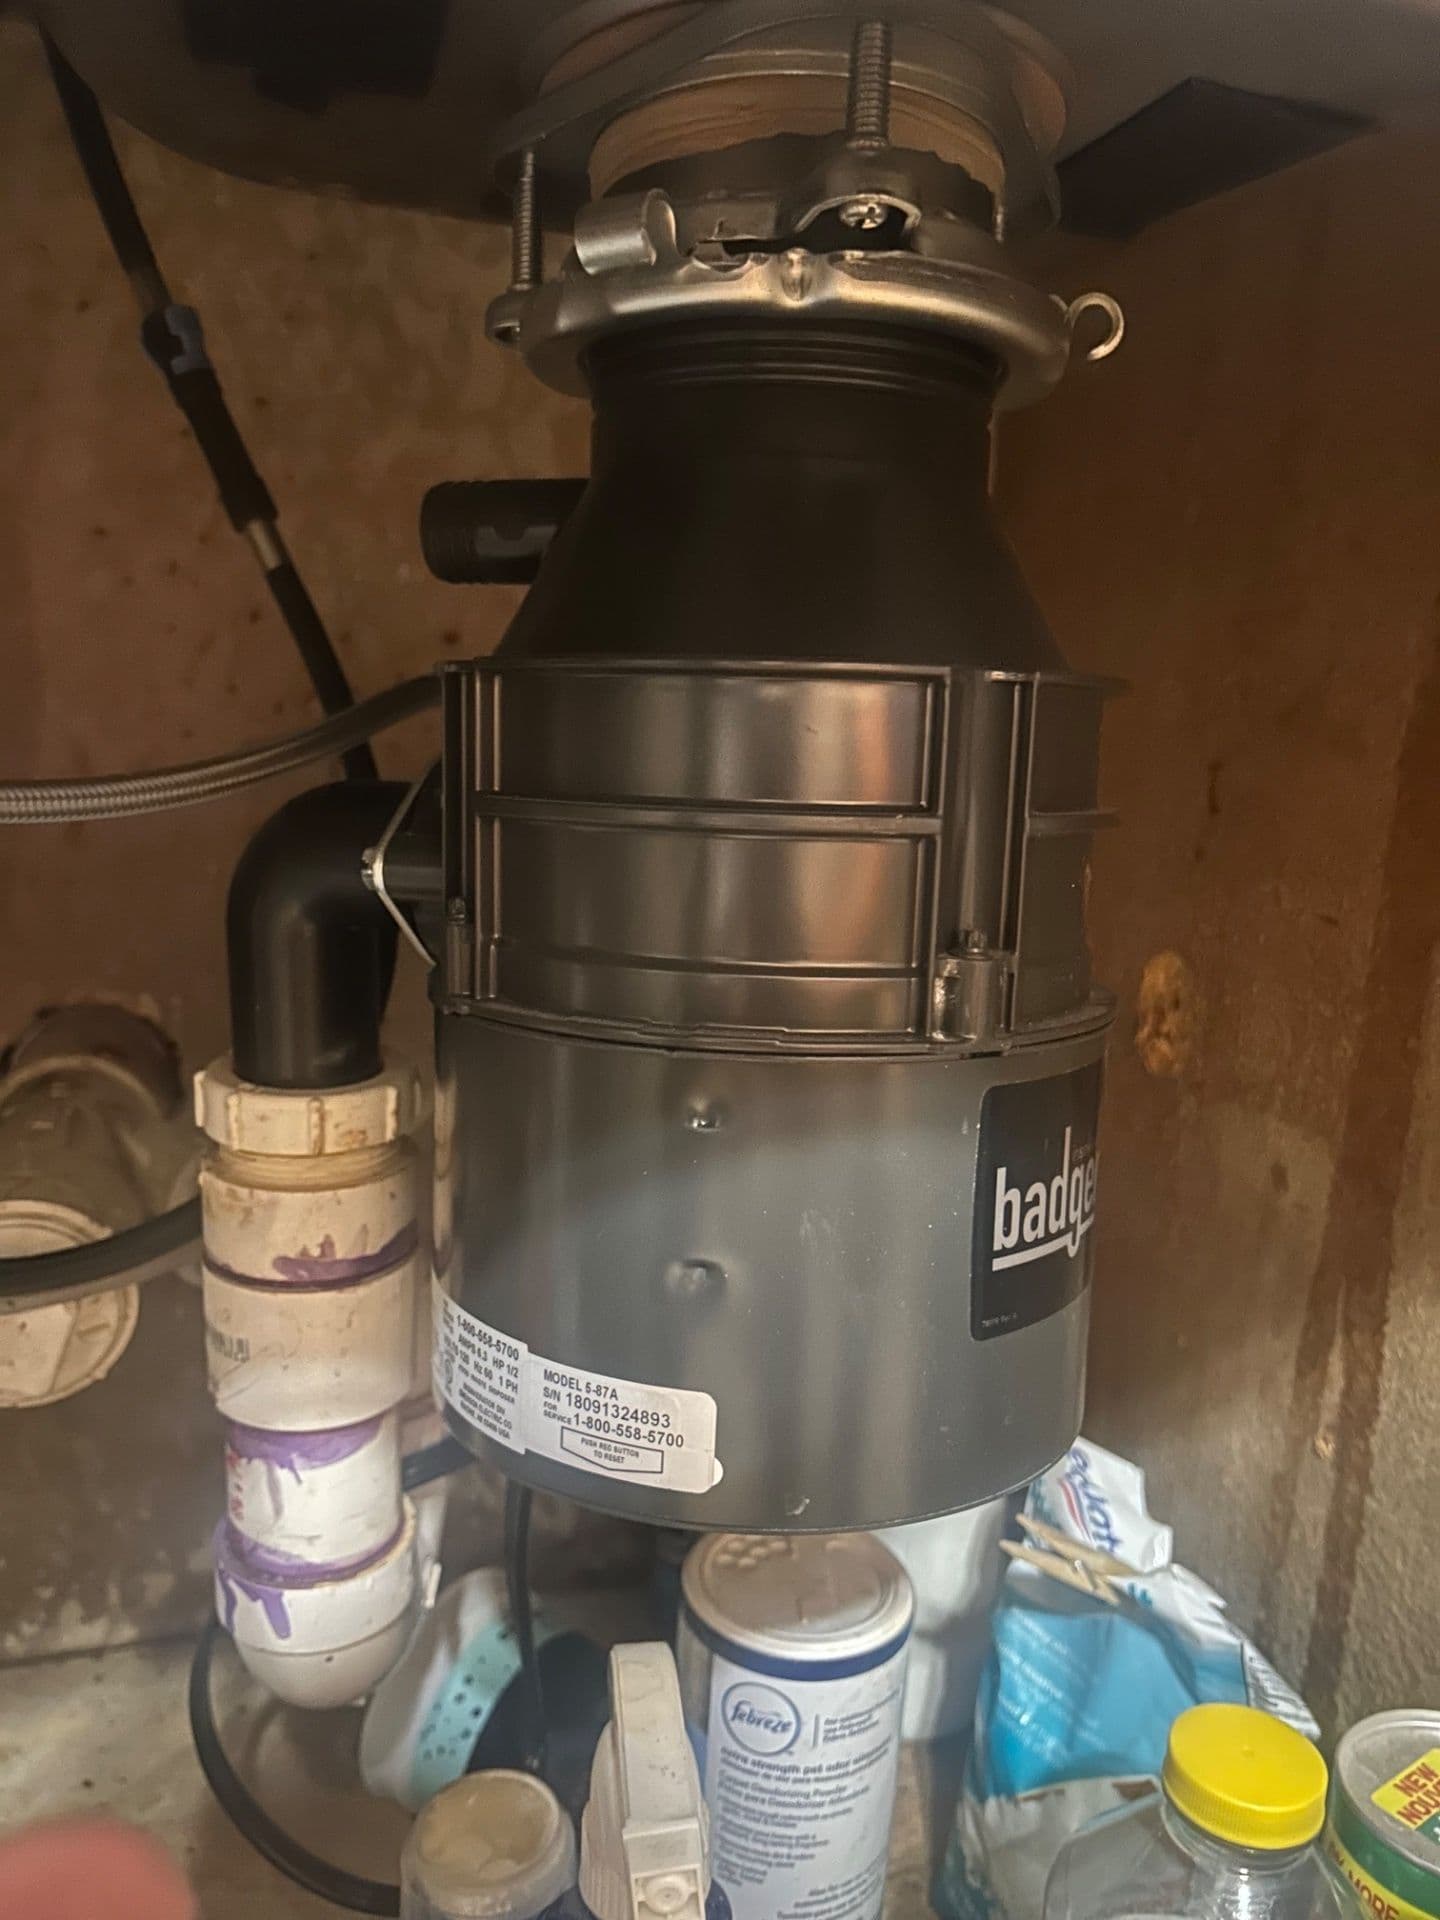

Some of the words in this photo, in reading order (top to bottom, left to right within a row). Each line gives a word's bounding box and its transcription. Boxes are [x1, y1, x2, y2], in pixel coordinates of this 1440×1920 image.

[474, 1360, 483, 1375] Hz
[499, 1376, 503, 1387] 1
[505, 1378, 518, 1394] PH
[492, 1356, 505, 1370] HP
[506, 1363, 519, 1378] 1/2
[543, 1369, 582, 1392] MODEL
[585, 1381, 619, 1401] 5-87A
[543, 1401, 558, 1411] FOR
[543, 1386, 561, 1402] S/N
[566, 1392, 671, 1428] 18091324893
[543, 1410, 572, 1425] SERVICE
[573, 1413, 685, 1448] 1-800-558-5700
[581, 1437, 598, 1448] PUSH
[599, 1442, 612, 1452] RED
[614, 1445, 640, 1458] BUTTON
[594, 1450, 603, 1459] TO
[604, 1452, 625, 1464] RESET
[1066, 1447, 1122, 1553] equat
[750, 1759, 800, 1774] strength
[803, 1764, 823, 1775] pet
[1393, 1762, 1439, 1798] NEW
